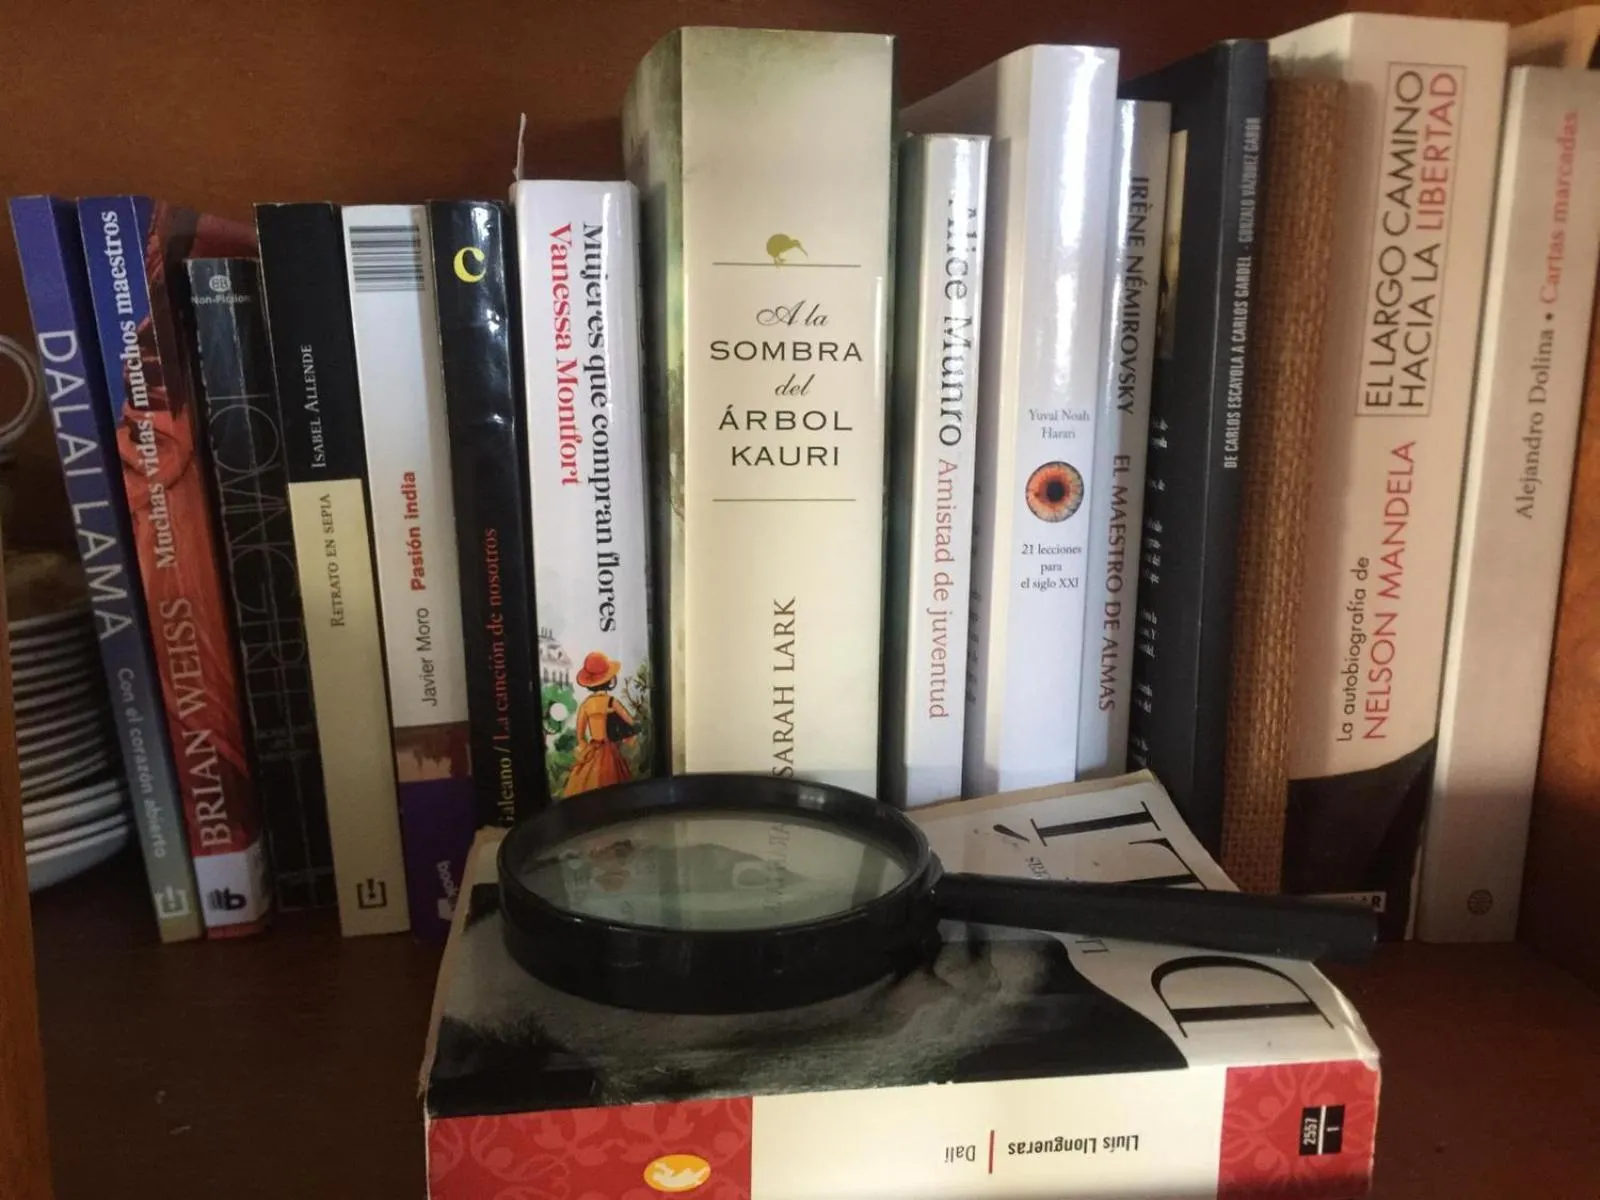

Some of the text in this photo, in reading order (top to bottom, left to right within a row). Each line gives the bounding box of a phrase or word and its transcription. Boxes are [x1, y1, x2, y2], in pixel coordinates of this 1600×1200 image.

[1365, 70, 1424, 409] EL LARGO CAMINO
[1398, 72, 1458, 409] HACIA LA LIBERTAD
[1116, 177, 1154, 416] IRÈNE NÉMIROVSKY
[1235, 255, 1251, 298] GARDEL
[756, 300, 828, 327] A la
[1231, 345, 1246, 353] A
[1232, 302, 1248, 343] CARLOS
[1516, 111, 1579, 519] Alejandro Dolina Cartas marcadas
[549, 223, 583, 486] Vanessa Monfort
[710, 341, 863, 362] SOMBRA
[774, 373, 816, 397] del
[938, 316, 972, 446] Munro
[1228, 356, 1244, 408] ESCAYOLA
[102, 210, 179, 568] Muchas vidas, muchos maestros
[300, 344, 327, 470] ISABEL ALLENDE
[719, 405, 853, 431] ÁRBOL
[1028, 409, 1090, 422] Yuval Noah
[581, 222, 620, 633] Mujeres que compran flores
[731, 446, 840, 466] KAURI
[1041, 427, 1076, 440] Harari
[1224, 456, 1237, 469] DE
[1225, 411, 1241, 452] CARLOS
[38, 329, 133, 639] DALAI LAMA
[320, 492, 345, 628] RETRATO EN SEPIA
[484, 528, 502, 608] nosotros
[1020, 578, 1079, 592] el siglo XXI
[1021, 543, 1082, 555] 21 lecciones
[1040, 562, 1063, 574] para
[1099, 454, 1131, 712] EL MAESTRO DE ALMAS
[400, 472, 438, 707] Javier Moro Pasión india
[927, 459, 959, 719] Amistad de juventud
[1363, 440, 1417, 740] NELSON MANDELA
[485, 615, 504, 637] de
[1337, 556, 1370, 743] La autobiografía de
[487, 640, 509, 712] canción
[771, 596, 797, 778] SARAH LARK
[160, 598, 232, 847] BRIAN WEISS
[117, 667, 165, 858] Con el corazón abierto
[945, 1144, 976, 1163] Dalí
[1007, 1134, 1139, 1157] Lluís Llongueras
[1302, 1117, 1318, 1146] 2557
